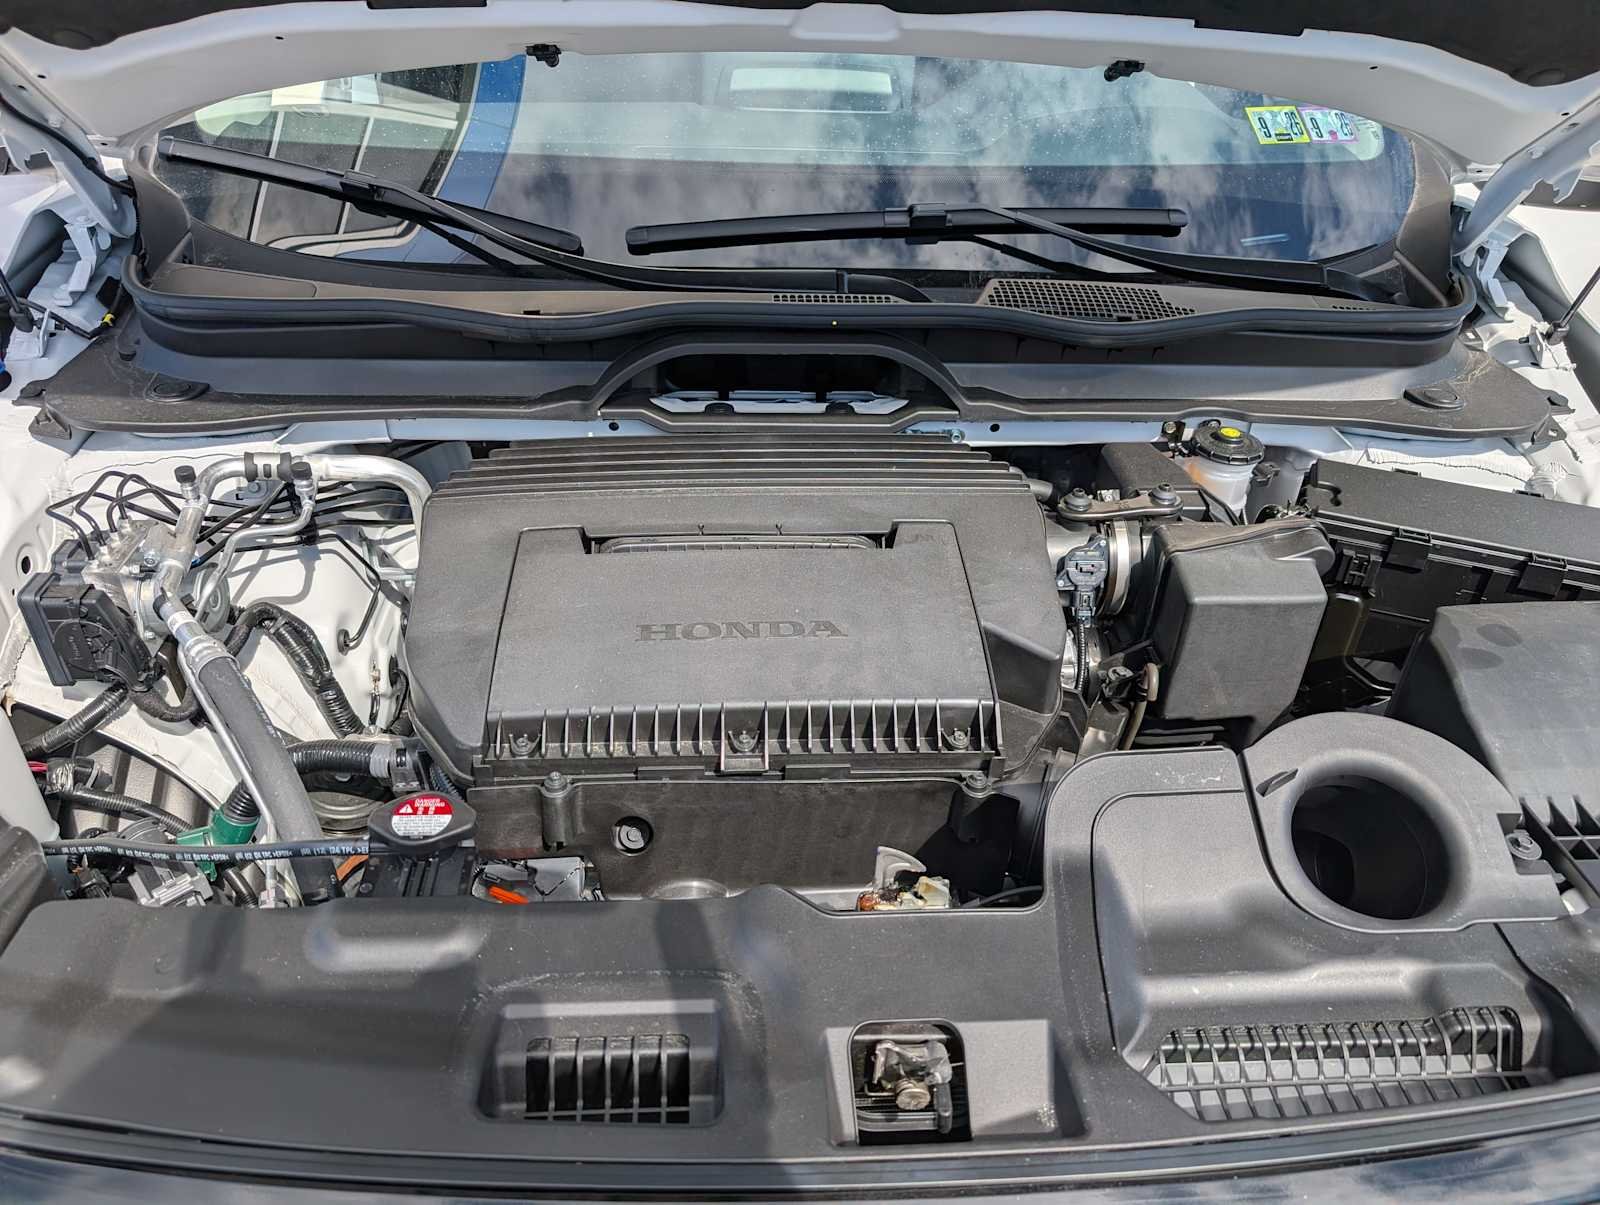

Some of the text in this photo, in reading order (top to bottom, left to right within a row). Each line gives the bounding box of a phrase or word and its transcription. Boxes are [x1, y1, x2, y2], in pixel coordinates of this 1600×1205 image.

[1258, 111, 1304, 138] 9 26
[1309, 117, 1323, 138] 9
[635, 620, 848, 641] HONDA
